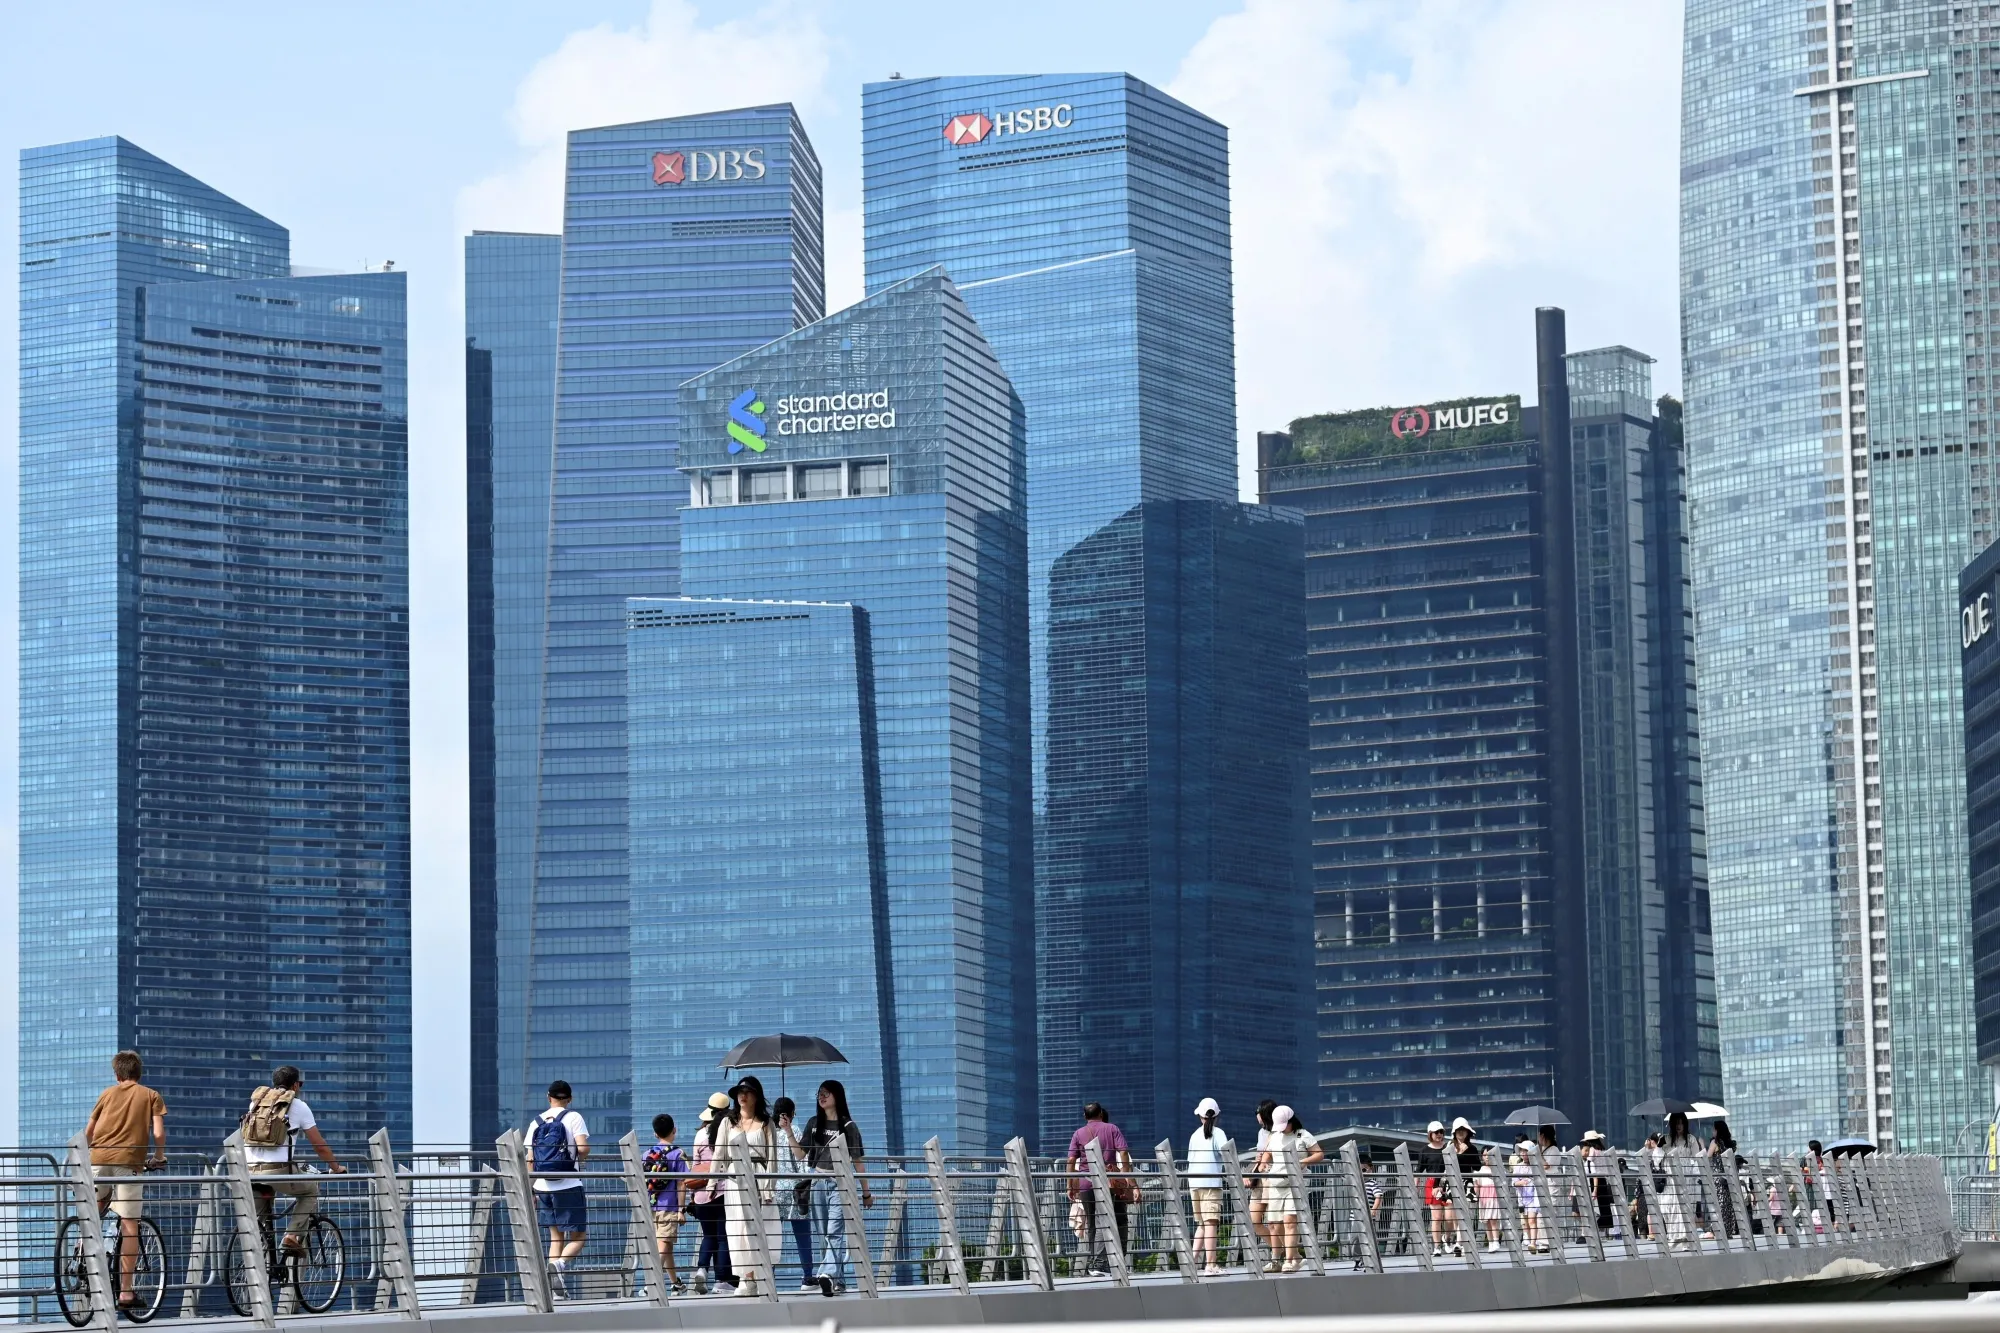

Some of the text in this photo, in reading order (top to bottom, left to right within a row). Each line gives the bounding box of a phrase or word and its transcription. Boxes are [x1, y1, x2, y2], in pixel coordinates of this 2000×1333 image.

[995, 103, 1073, 137] HSBC
[690, 148, 766, 182] DBS
[777, 388, 888, 415] standard
[777, 409, 896, 436] chartered
[1435, 403, 1509, 431] MUFG
